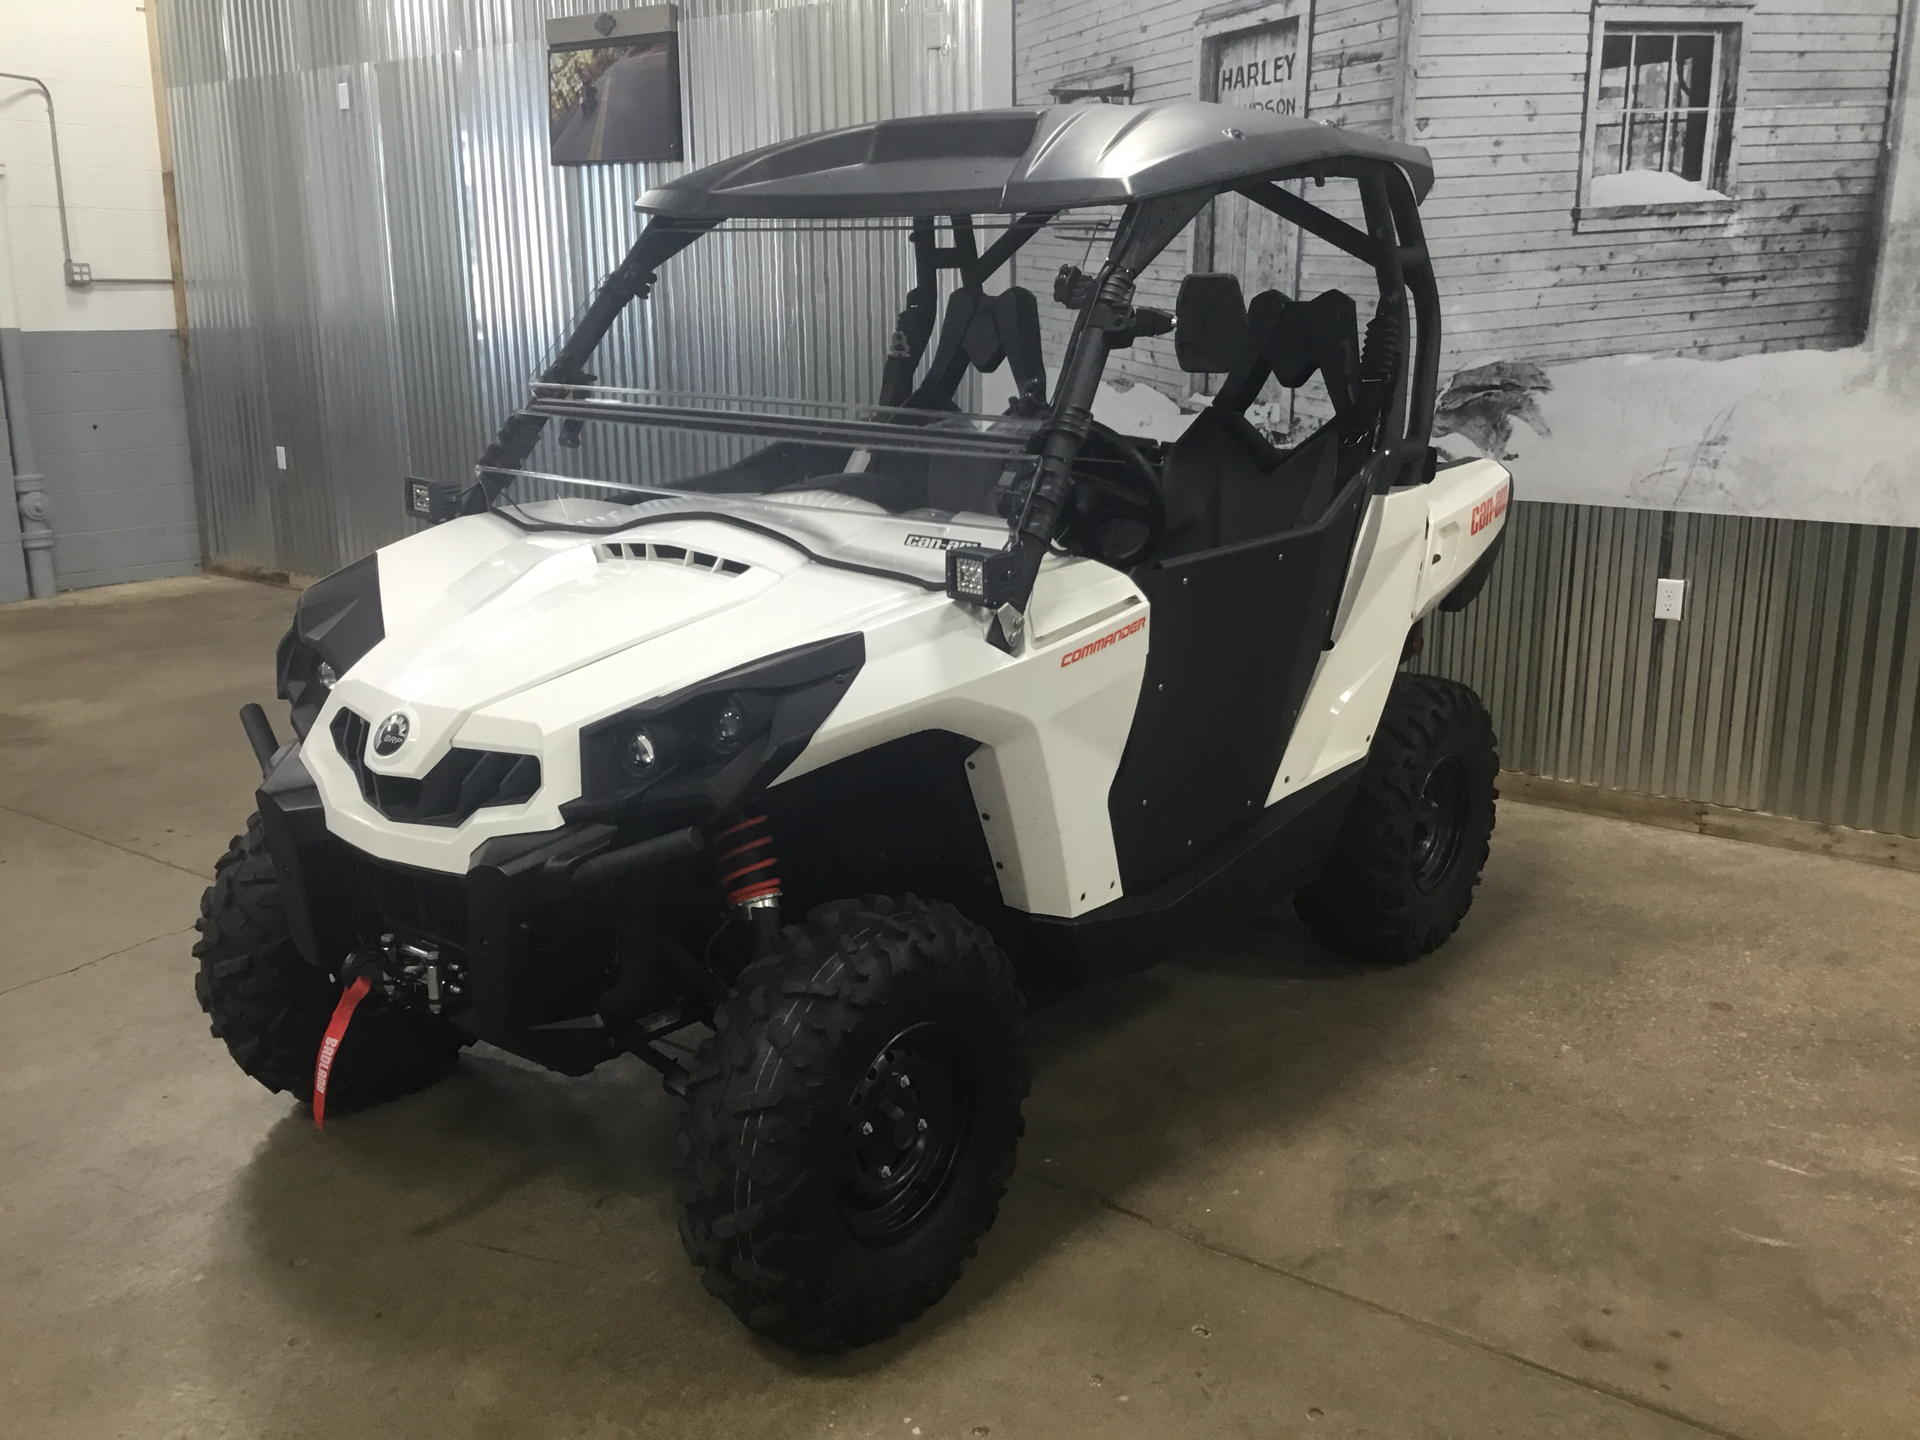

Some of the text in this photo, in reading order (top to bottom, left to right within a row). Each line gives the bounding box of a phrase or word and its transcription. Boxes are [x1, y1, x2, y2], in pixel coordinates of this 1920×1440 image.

[1221, 52, 1296, 91] HARLEY
[1244, 97, 1296, 116] DSON
[1061, 616, 1146, 668] COMMANDER
[383, 734, 403, 744] BRP
[316, 1036, 339, 1094] BADLAND
